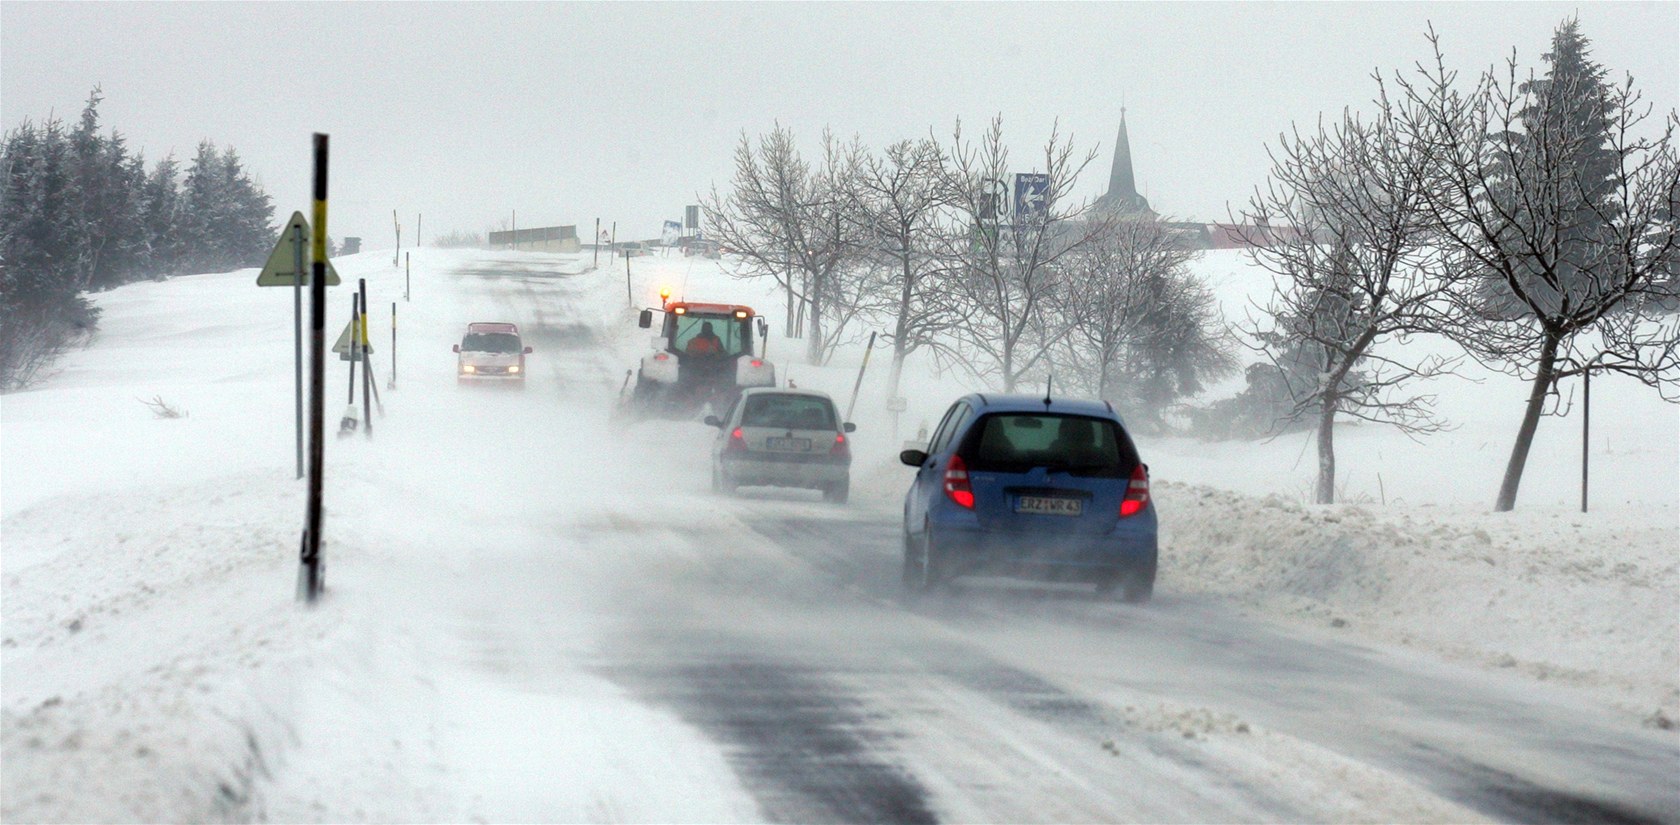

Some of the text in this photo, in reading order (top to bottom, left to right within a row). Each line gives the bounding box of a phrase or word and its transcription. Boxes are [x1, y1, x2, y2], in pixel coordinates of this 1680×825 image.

[1020, 498, 1080, 512] ERZ WR 43
